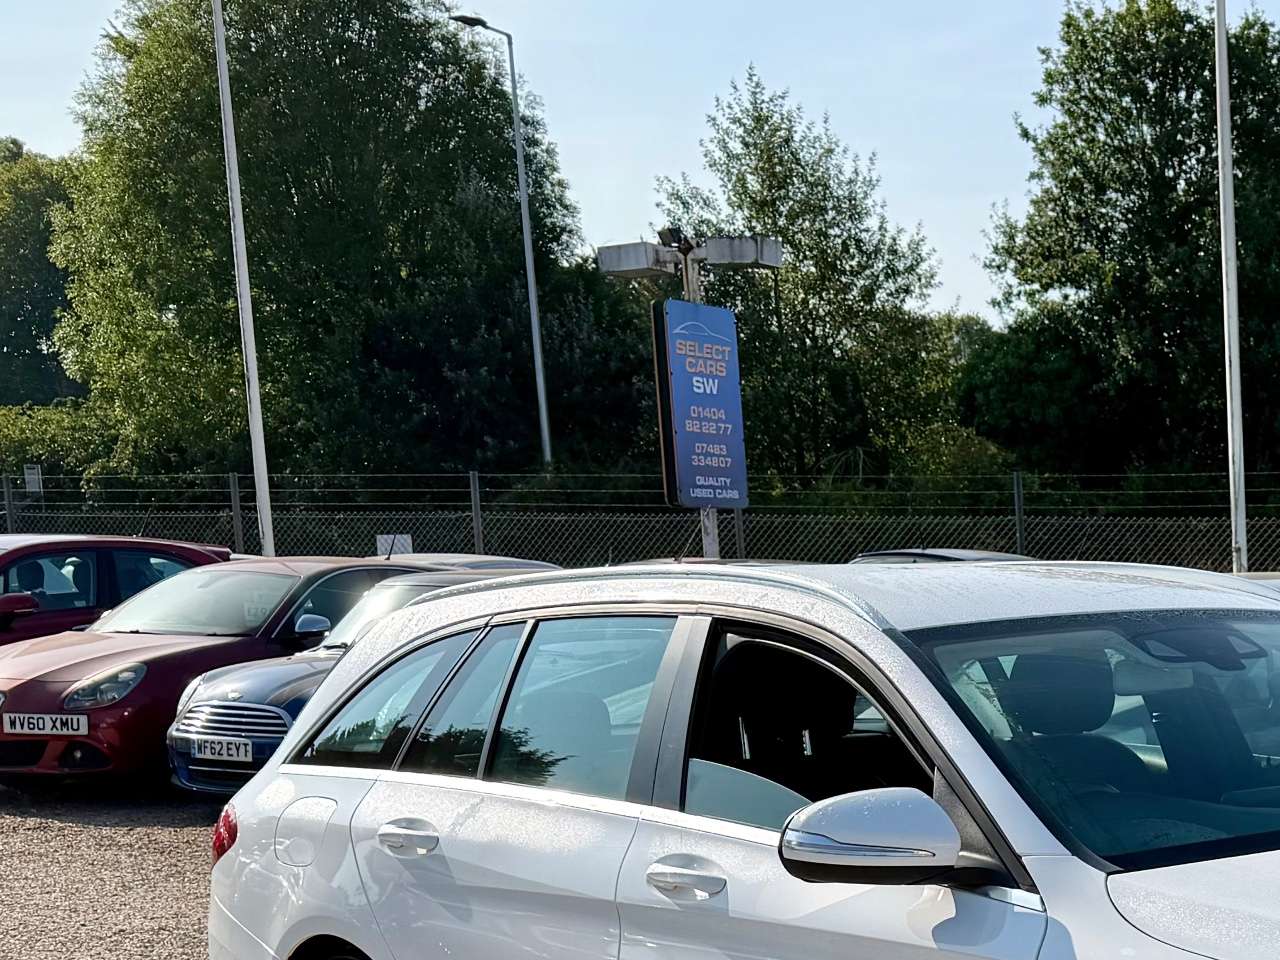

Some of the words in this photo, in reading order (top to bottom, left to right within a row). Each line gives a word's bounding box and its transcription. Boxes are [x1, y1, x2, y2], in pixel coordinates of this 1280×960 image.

[675, 339, 732, 361] SELECT
[685, 357, 727, 377] CARS
[692, 376, 718, 395] SW
[690, 405, 726, 420] 01404
[695, 475, 732, 487] QUALITY
[690, 487, 715, 498] USED
[715, 488, 739, 499] CARS
[8, 716, 46, 731] WV60
[50, 717, 80, 732] XMU
[226, 742, 250, 758] EYT
